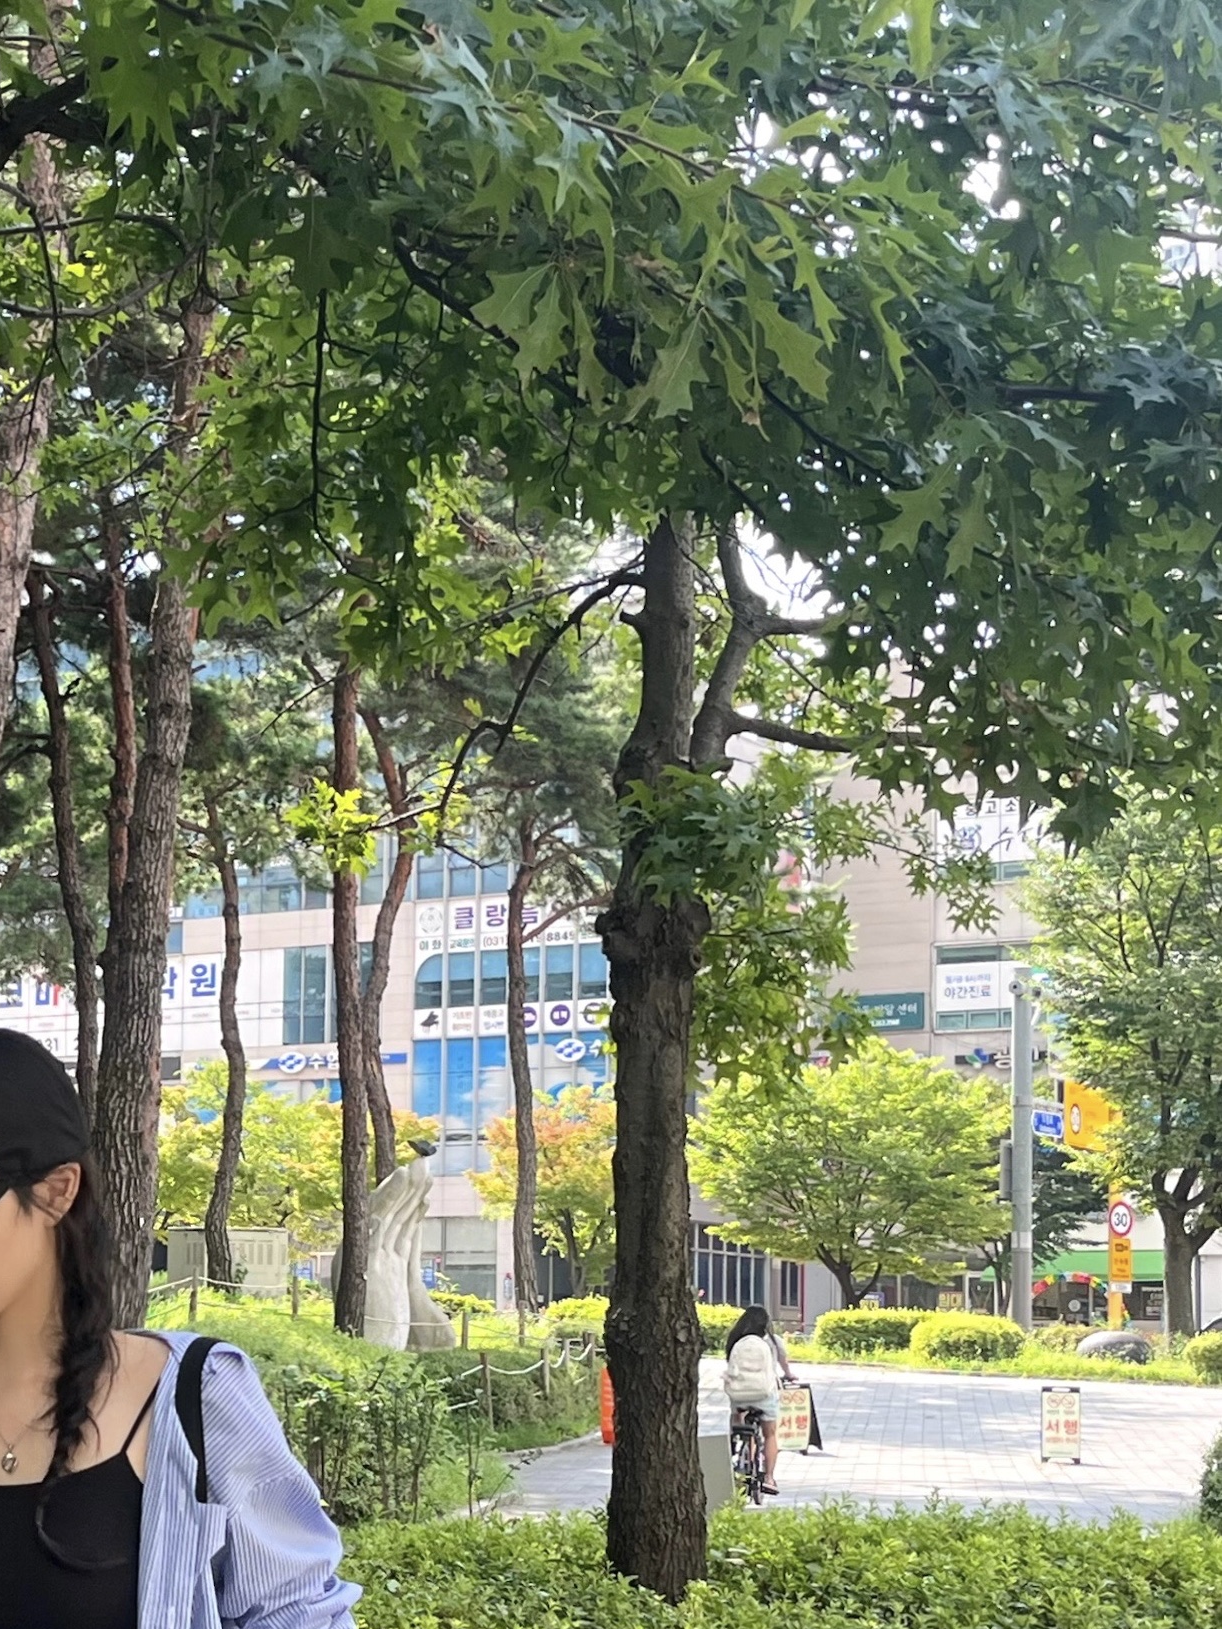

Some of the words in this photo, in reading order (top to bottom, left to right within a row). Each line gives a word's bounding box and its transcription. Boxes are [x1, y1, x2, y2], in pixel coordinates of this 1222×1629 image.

[944, 985, 992, 999] 야간진료
[897, 1002, 917, 1015] 센터
[1114, 1211, 1128, 1227] 30
[1045, 1419, 1078, 1435] 서행
